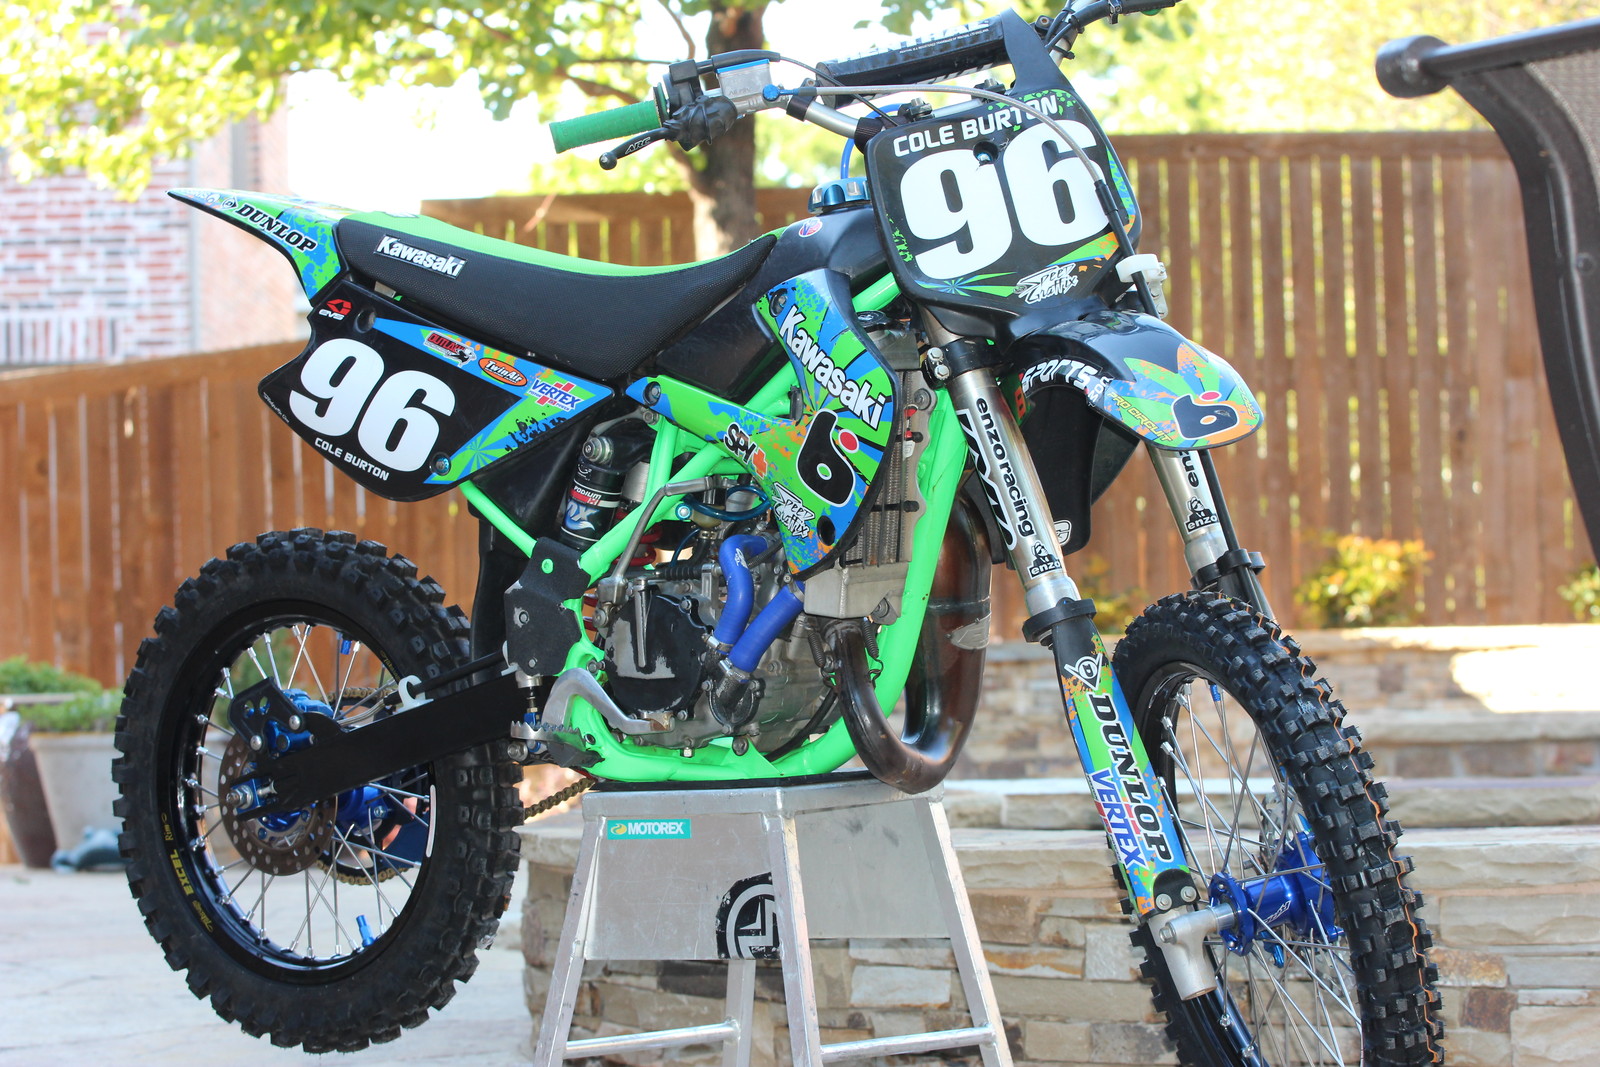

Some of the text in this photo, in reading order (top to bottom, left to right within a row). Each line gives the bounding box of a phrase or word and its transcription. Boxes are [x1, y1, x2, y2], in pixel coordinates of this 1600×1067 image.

[893, 94, 1058, 157] COLE BURTON
[900, 119, 1110, 280] 96
[235, 203, 318, 253] DUNLOP
[376, 235, 466, 277] Kawasaki
[318, 308, 345, 321] EVS
[779, 305, 886, 431] Kawasaki
[1021, 358, 1099, 394] SPORTS
[289, 338, 456, 473] 96
[531, 379, 581, 409] VERTEX
[1106, 391, 1174, 443] PRO CIRCUIT
[314, 436, 390, 482] COLE BURTON
[975, 397, 1035, 538] enzo racing
[1186, 515, 1218, 531] enzo
[1030, 561, 1062, 576] enzo
[1089, 692, 1174, 864] DUNLOP
[627, 821, 685, 836] MOTOREX
[1090, 768, 1149, 870] VERTEX
[170, 848, 195, 897] EXCEL
